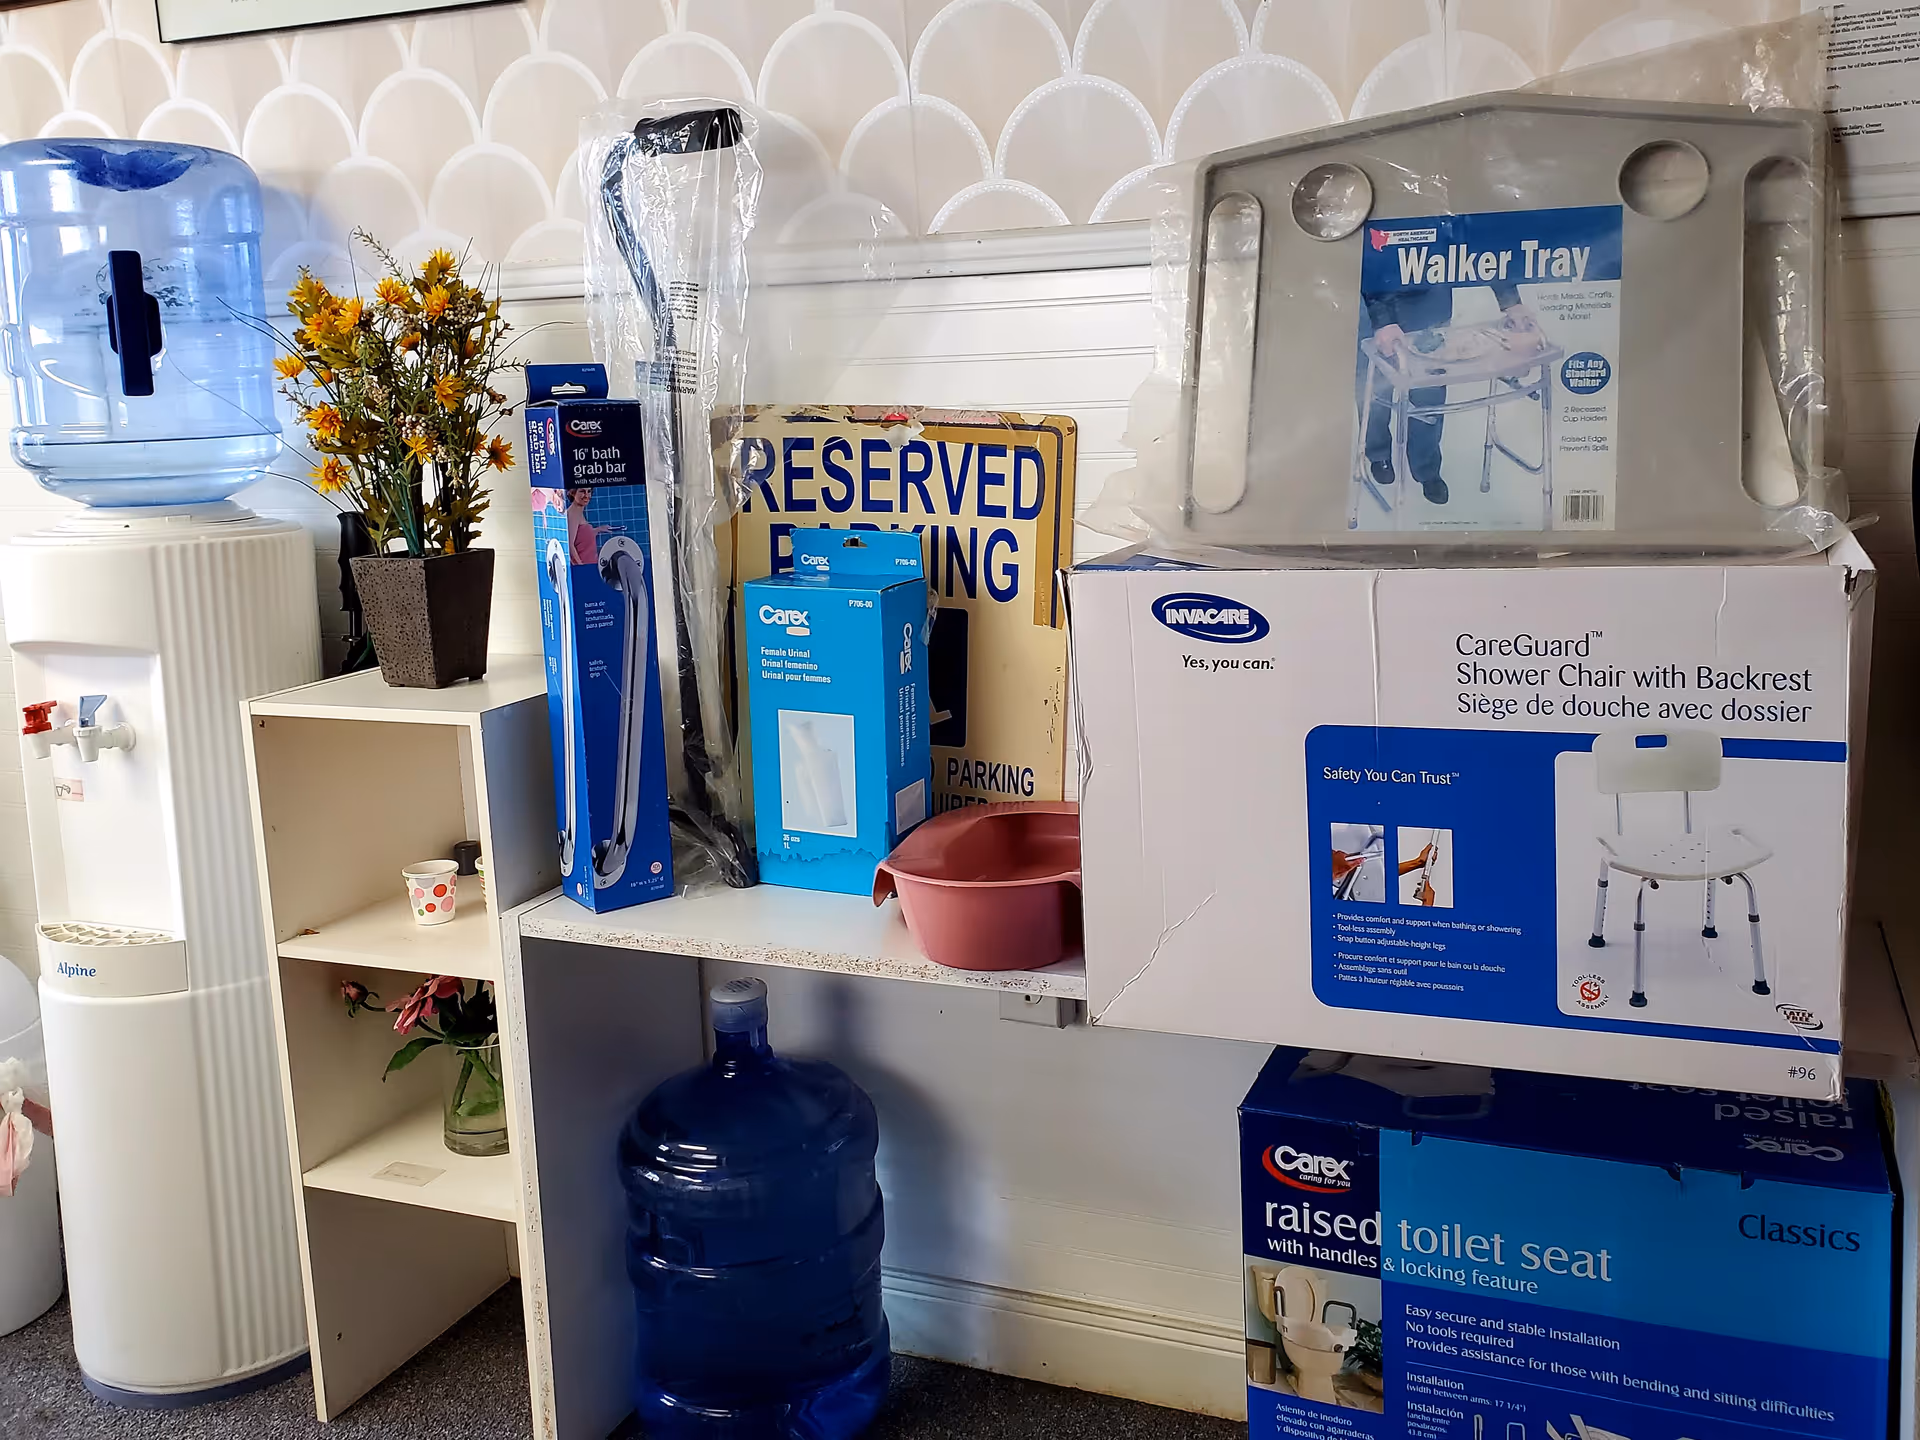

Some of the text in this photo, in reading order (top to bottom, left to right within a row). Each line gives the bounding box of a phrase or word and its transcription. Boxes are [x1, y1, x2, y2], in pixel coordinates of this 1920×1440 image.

[1398, 240, 1590, 285] Walker Tray
[571, 419, 602, 431] Carex
[1563, 415, 1578, 423] Cup
[531, 420, 540, 450] grab
[539, 440, 547, 470] bath
[573, 446, 620, 460] 16" bath
[573, 461, 626, 478] grab bar
[740, 435, 1046, 521] RESERVED
[769, 523, 1020, 603] PING
[801, 554, 829, 566] Carex
[849, 599, 873, 608] P706-00
[759, 605, 809, 626] Carex
[1165, 608, 1249, 625] INVACARE
[761, 647, 811, 658] Female Urinal
[903, 623, 913, 673] Carex
[761, 659, 818, 671] Orinal femenino
[1182, 655, 1274, 672] Yes, you can.
[762, 670, 832, 684] Urinal pour femmes
[1456, 662, 1812, 692] Shower Chair with Backrest
[1457, 692, 1812, 723] Siège de douche avec dossier
[948, 757, 1035, 797] PARKING
[1323, 766, 1361, 784] Safety
[1364, 768, 1388, 782] You
[1391, 770, 1416, 783] Can
[1337, 913, 1364, 922] Provides
[1365, 915, 1390, 924] comfort
[1392, 917, 1405, 925] and
[1405, 918, 1431, 928] support
[1432, 920, 1450, 929] when
[1451, 921, 1477, 932] bathing
[1486, 924, 1522, 936] showering
[1337, 924, 1396, 936] Tool-less assembly
[1337, 935, 1446, 952] Snap button adjustable-height legs
[57, 961, 97, 978] Alpine
[1338, 952, 1363, 961] Procure
[1364, 954, 1388, 963] confort
[1388, 956, 1396, 964] et
[1396, 957, 1422, 967] support
[1422, 960, 1439, 968] pour
[1447, 961, 1462, 969] bain
[1472, 963, 1480, 971] la
[1480, 963, 1506, 973] douche
[1338, 963, 1408, 976] Assemblage sans outil
[1338, 973, 1357, 982] Pattes
[1363, 976, 1389, 985] hauteur
[1389, 977, 1415, 988] réglable
[1415, 981, 1431, 989] avec
[1432, 982, 1464, 992] poussoirs
[1576, 994, 1610, 1010] ASSEMBLY
[1783, 1010, 1814, 1018] LATEX
[1788, 1065, 1816, 1080] #96
[1714, 1103, 1854, 1129] raised
[1744, 1137, 1844, 1162] Carex
[1275, 1145, 1350, 1180] Carex
[1299, 1173, 1351, 1188] caring for you
[1265, 1201, 1612, 1282] raised toilet seat
[1738, 1214, 1860, 1252] Classics
[1267, 1238, 1538, 1294] with handles & locking feature
[1406, 1303, 1620, 1350] Easy secure and stable installation
[1406, 1320, 1514, 1349] No tools required
[1406, 1337, 1835, 1422] Provides assistance for those with bending and sitting difficulties
[1406, 1371, 1465, 1391] Installation
[1406, 1383, 1469, 1402] (width between
[1308, 1410, 1319, 1419] de
[1407, 1400, 1464, 1420] Instalación
[1276, 1414, 1375, 1440] elevado con agarraderas
